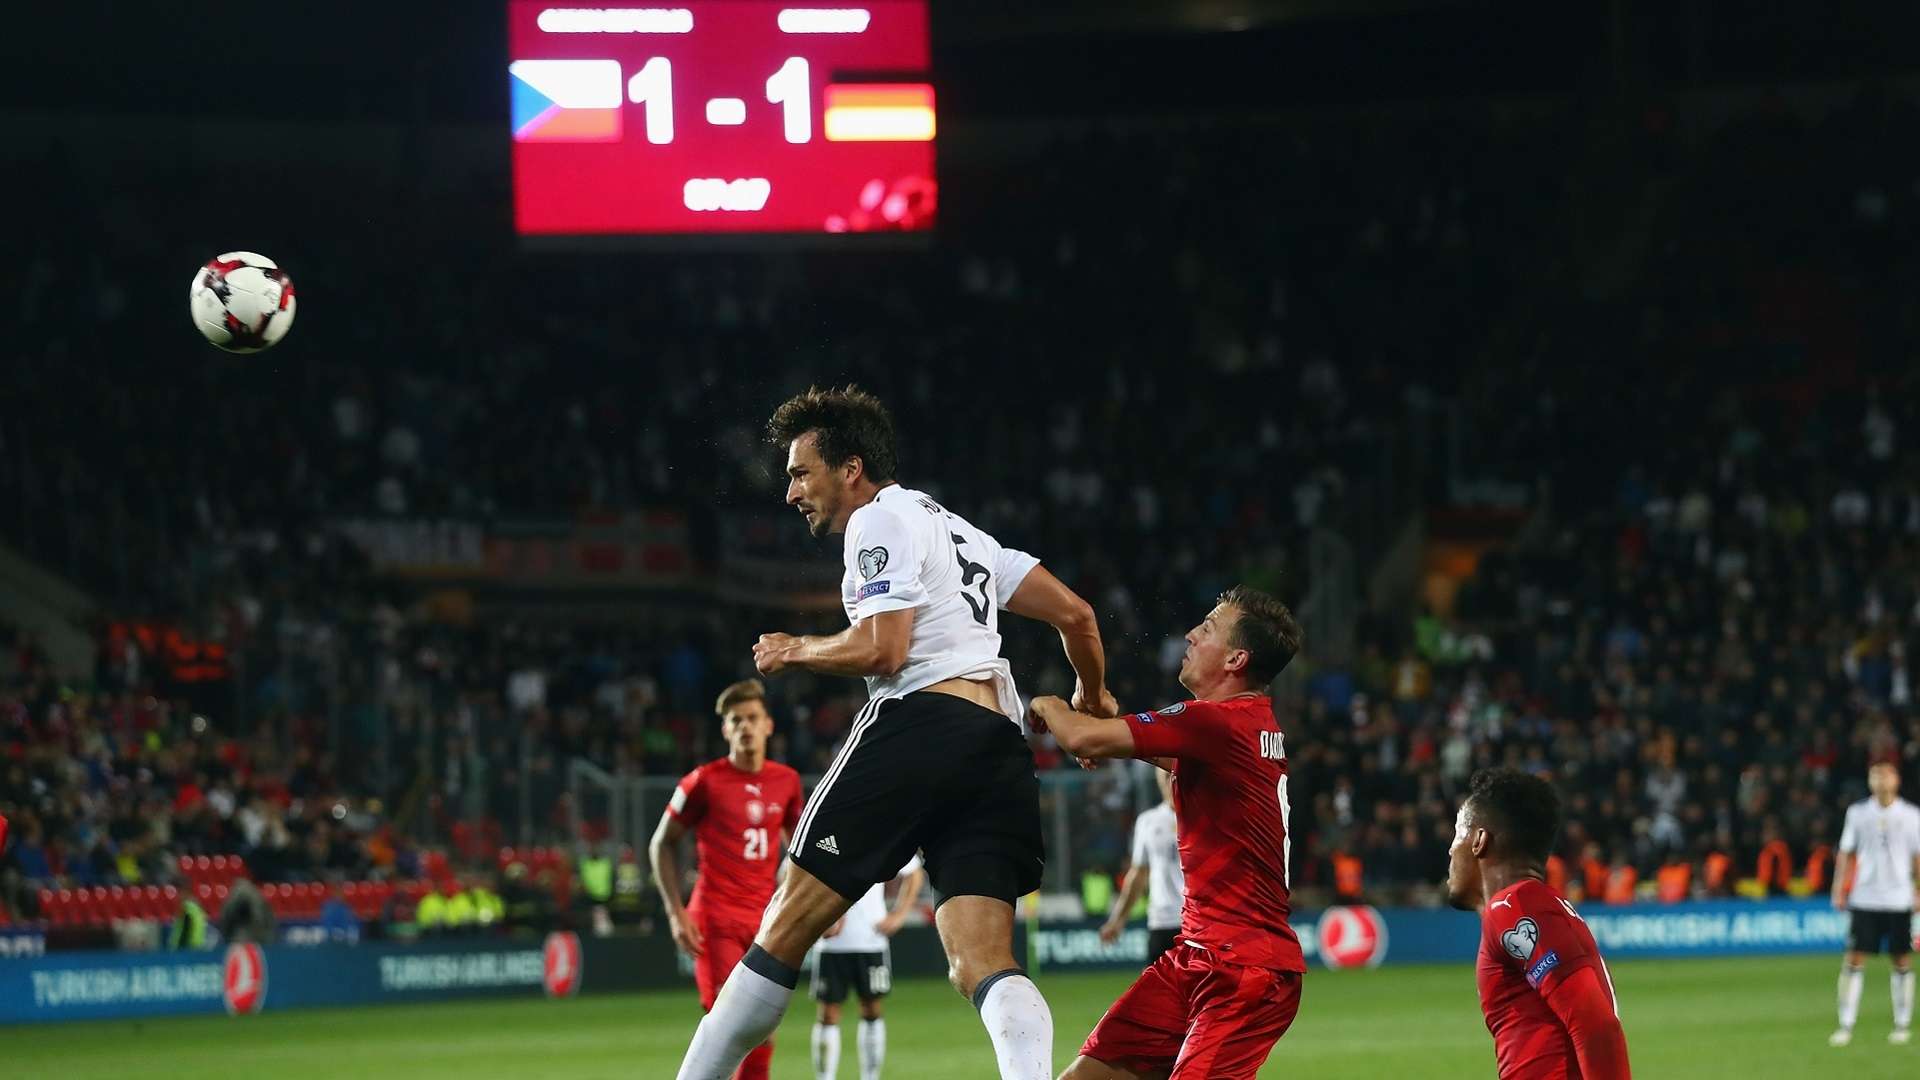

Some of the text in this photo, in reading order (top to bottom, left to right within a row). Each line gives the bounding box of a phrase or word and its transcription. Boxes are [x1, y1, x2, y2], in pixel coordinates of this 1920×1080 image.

[628, 57, 674, 144] 1
[766, 57, 811, 144] 1
[950, 531, 992, 625] 5
[743, 827, 768, 860] 21
[816, 842, 840, 855] adidas
[1531, 953, 1558, 979] RESPECT
